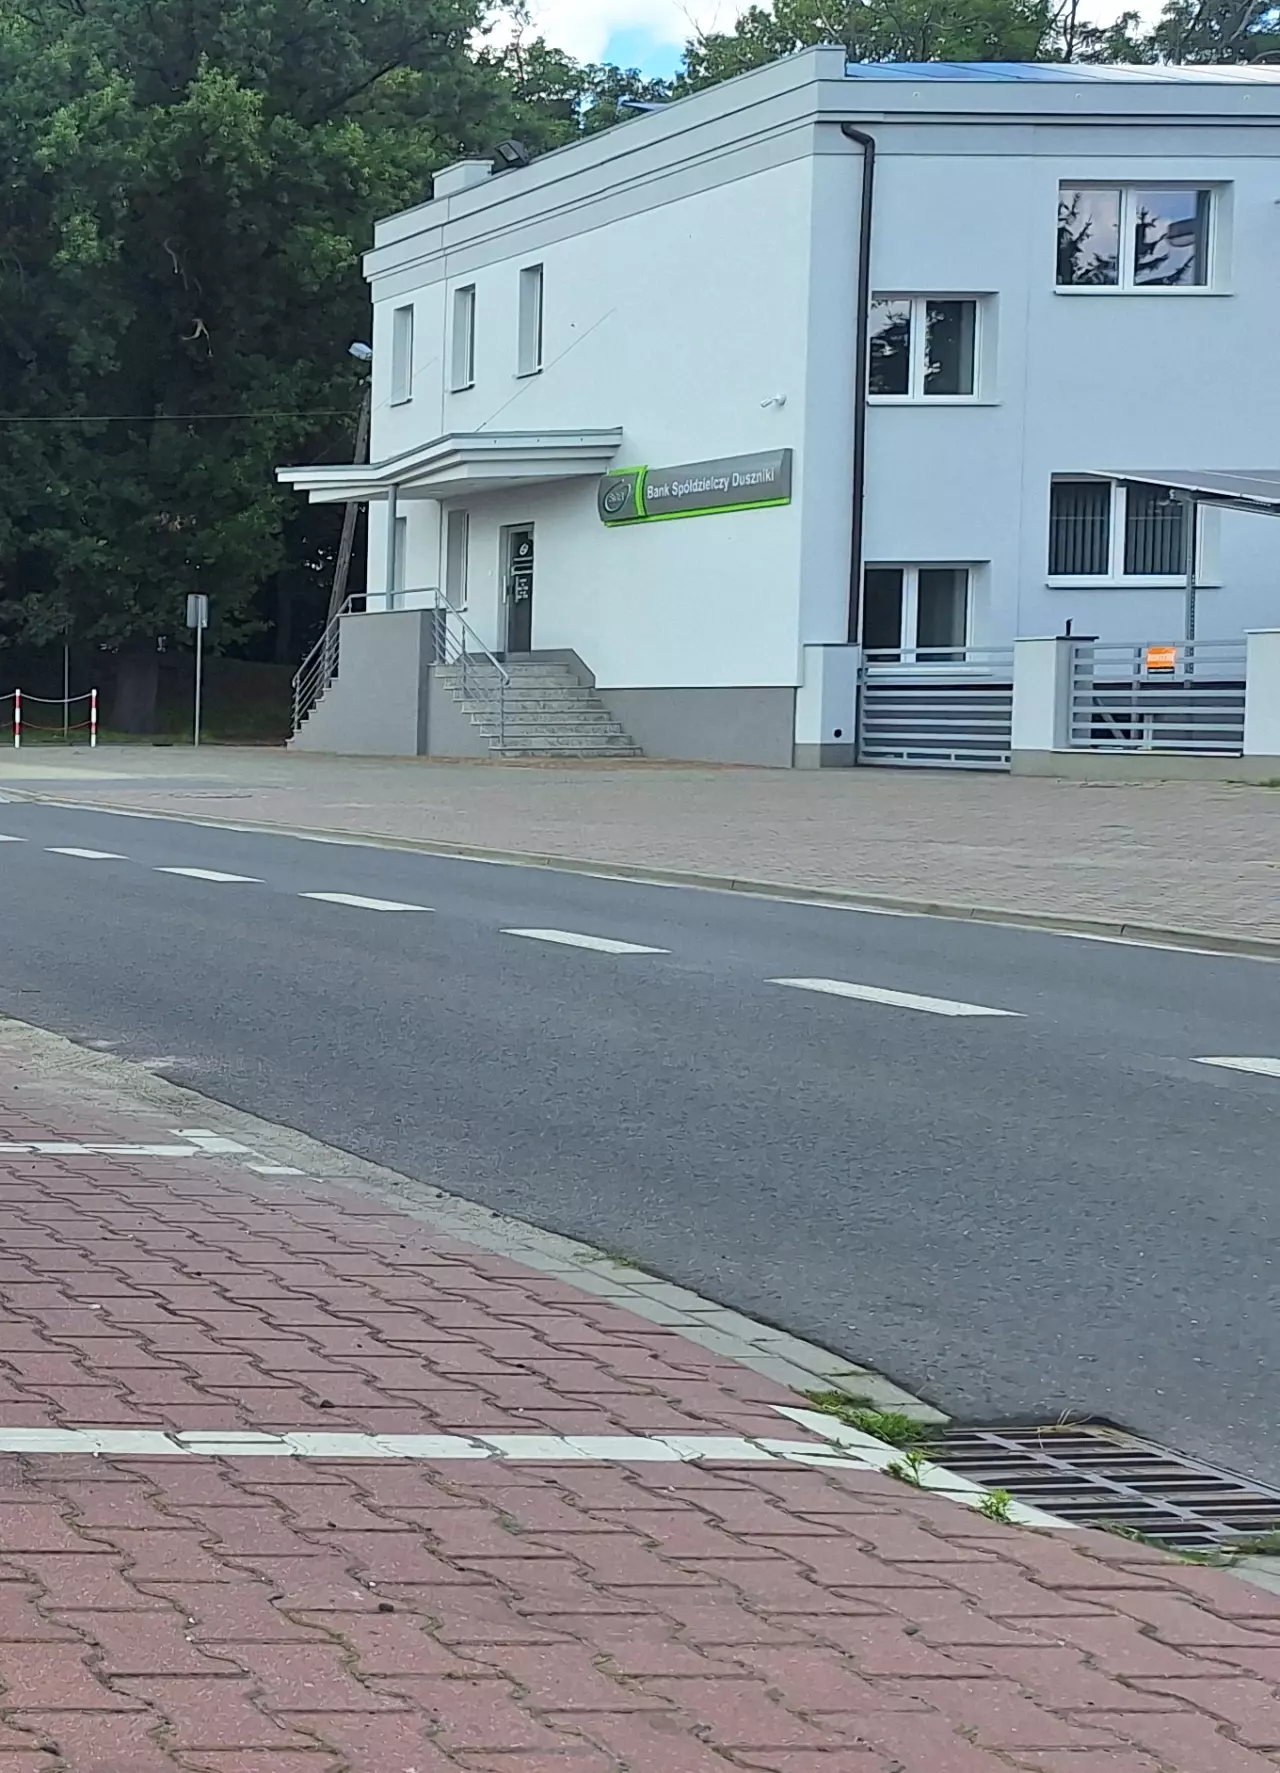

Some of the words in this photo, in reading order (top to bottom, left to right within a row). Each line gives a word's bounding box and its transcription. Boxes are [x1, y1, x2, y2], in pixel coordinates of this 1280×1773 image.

[647, 484, 670, 500] Bank
[671, 477, 730, 498] Spółdzielczy
[732, 467, 775, 487] Duszniki
